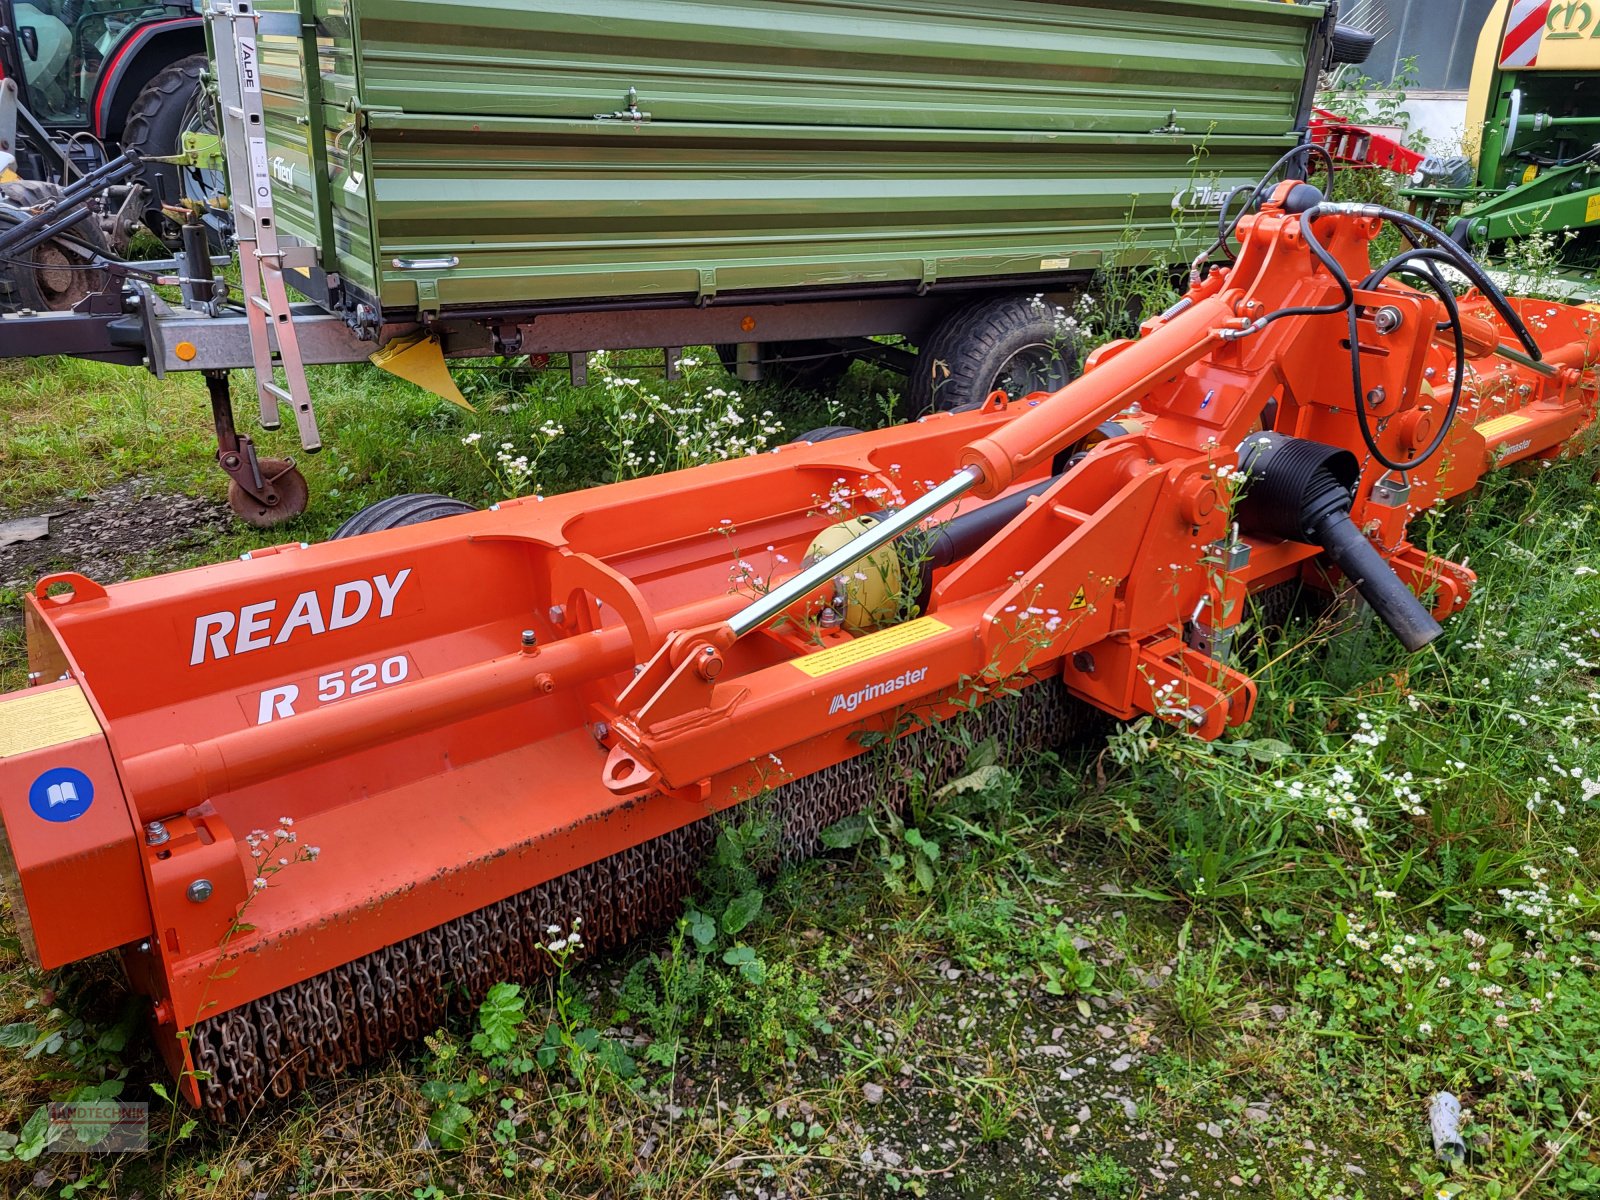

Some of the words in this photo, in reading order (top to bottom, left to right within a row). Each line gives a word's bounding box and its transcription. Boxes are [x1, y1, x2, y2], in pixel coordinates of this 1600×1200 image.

[189, 568, 413, 667] READY
[257, 684, 299, 725] R
[318, 655, 409, 702] 520
[828, 666, 928, 716] Agrimaster
